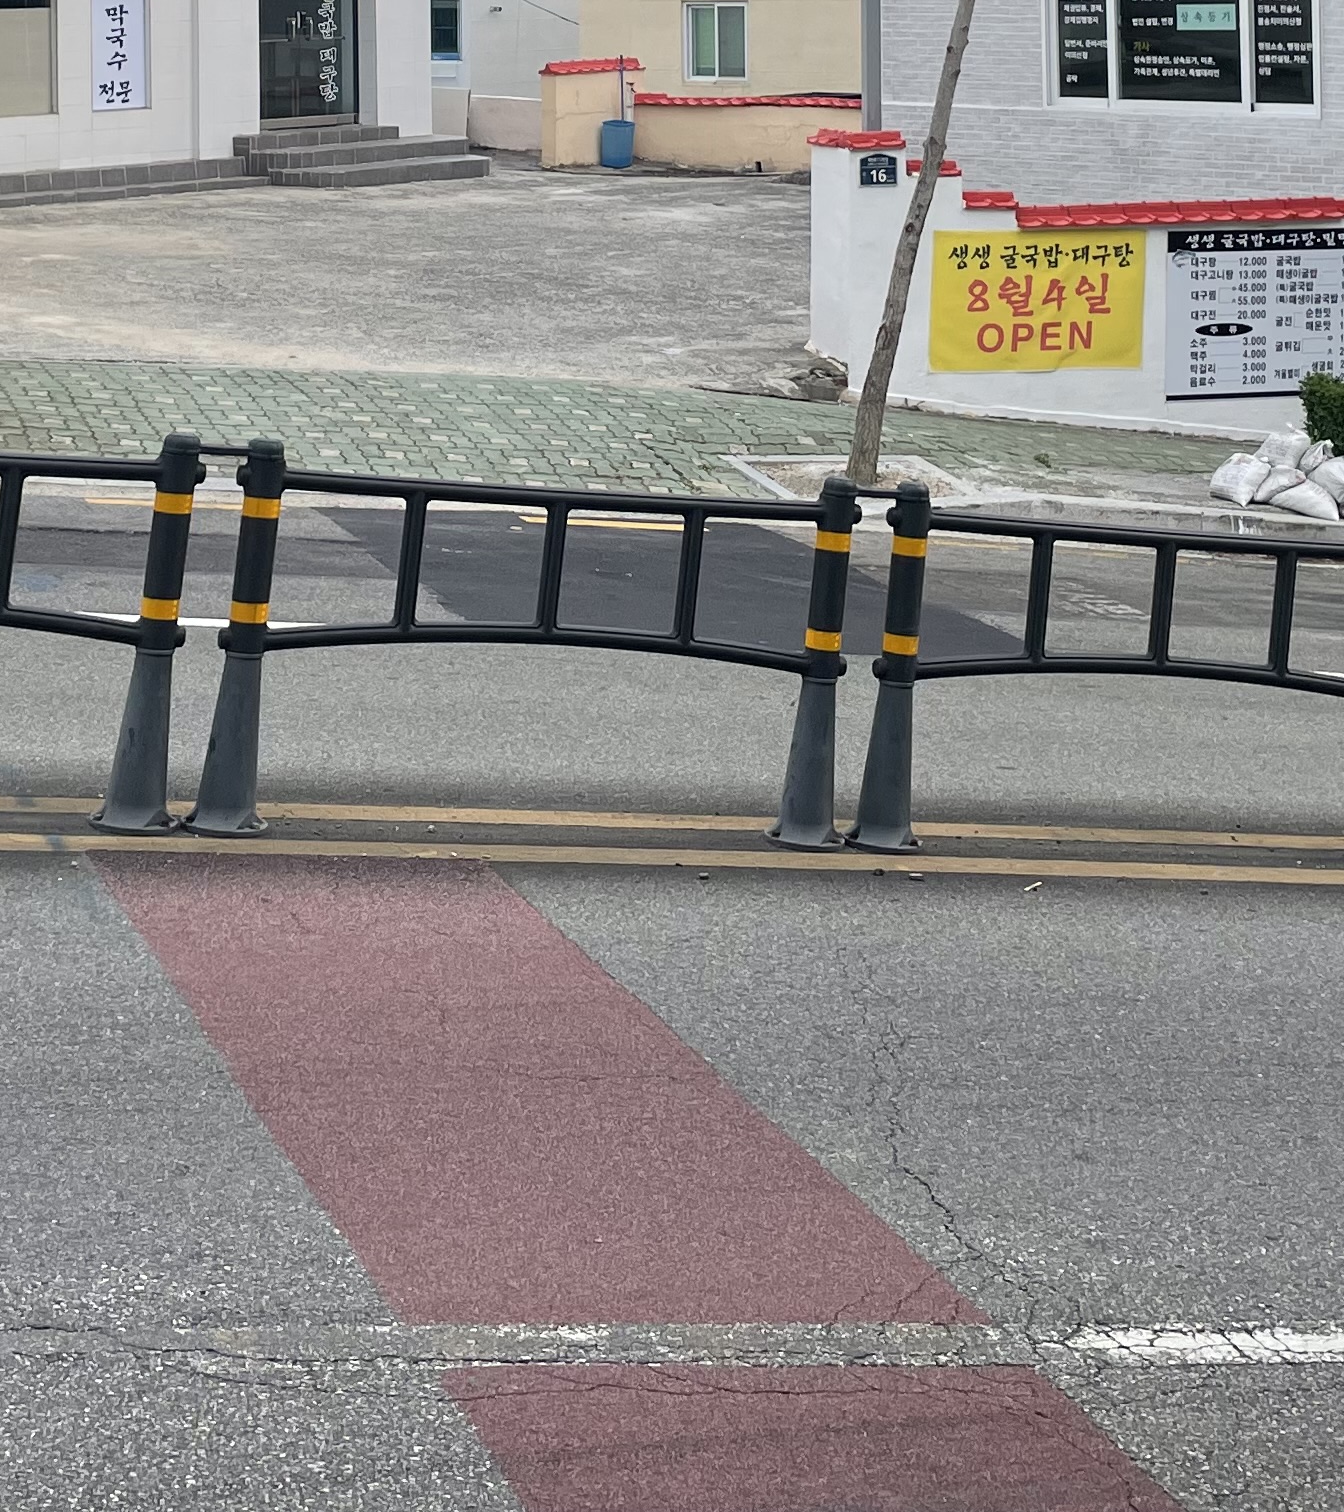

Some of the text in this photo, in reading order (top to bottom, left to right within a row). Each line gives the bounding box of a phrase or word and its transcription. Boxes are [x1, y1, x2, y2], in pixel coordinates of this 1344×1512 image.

[105, 4, 128, 71] 막국수
[320, 47, 339, 102] 대구탕
[99, 80, 132, 104] 전문
[870, 169, 887, 183] 16
[1185, 233, 1215, 249] 생생
[948, 244, 991, 270] 생생
[1190, 256, 1267, 268] 대구탕 12.000
[1276, 256, 1301, 266] 굴국밥
[1238, 269, 1267, 279] 13.000
[1237, 283, 1266, 292] 45.000
[1237, 296, 1266, 305] 55.000
[1191, 310, 1266, 320] 대구전 20.000
[1276, 316, 1292, 327] 굴전
[1306, 308, 1331, 318] 순한맛
[1306, 321, 1331, 331] 매운맛
[977, 320, 1093, 353] OPEN
[1190, 336, 1266, 348] 소주 3.000
[1275, 341, 1301, 352] 굴튀김
[1190, 349, 1266, 361] 맥주 4.000
[1190, 362, 1266, 374] 막걸리 3.000
[1189, 375, 1266, 387] 음료수 2.000
